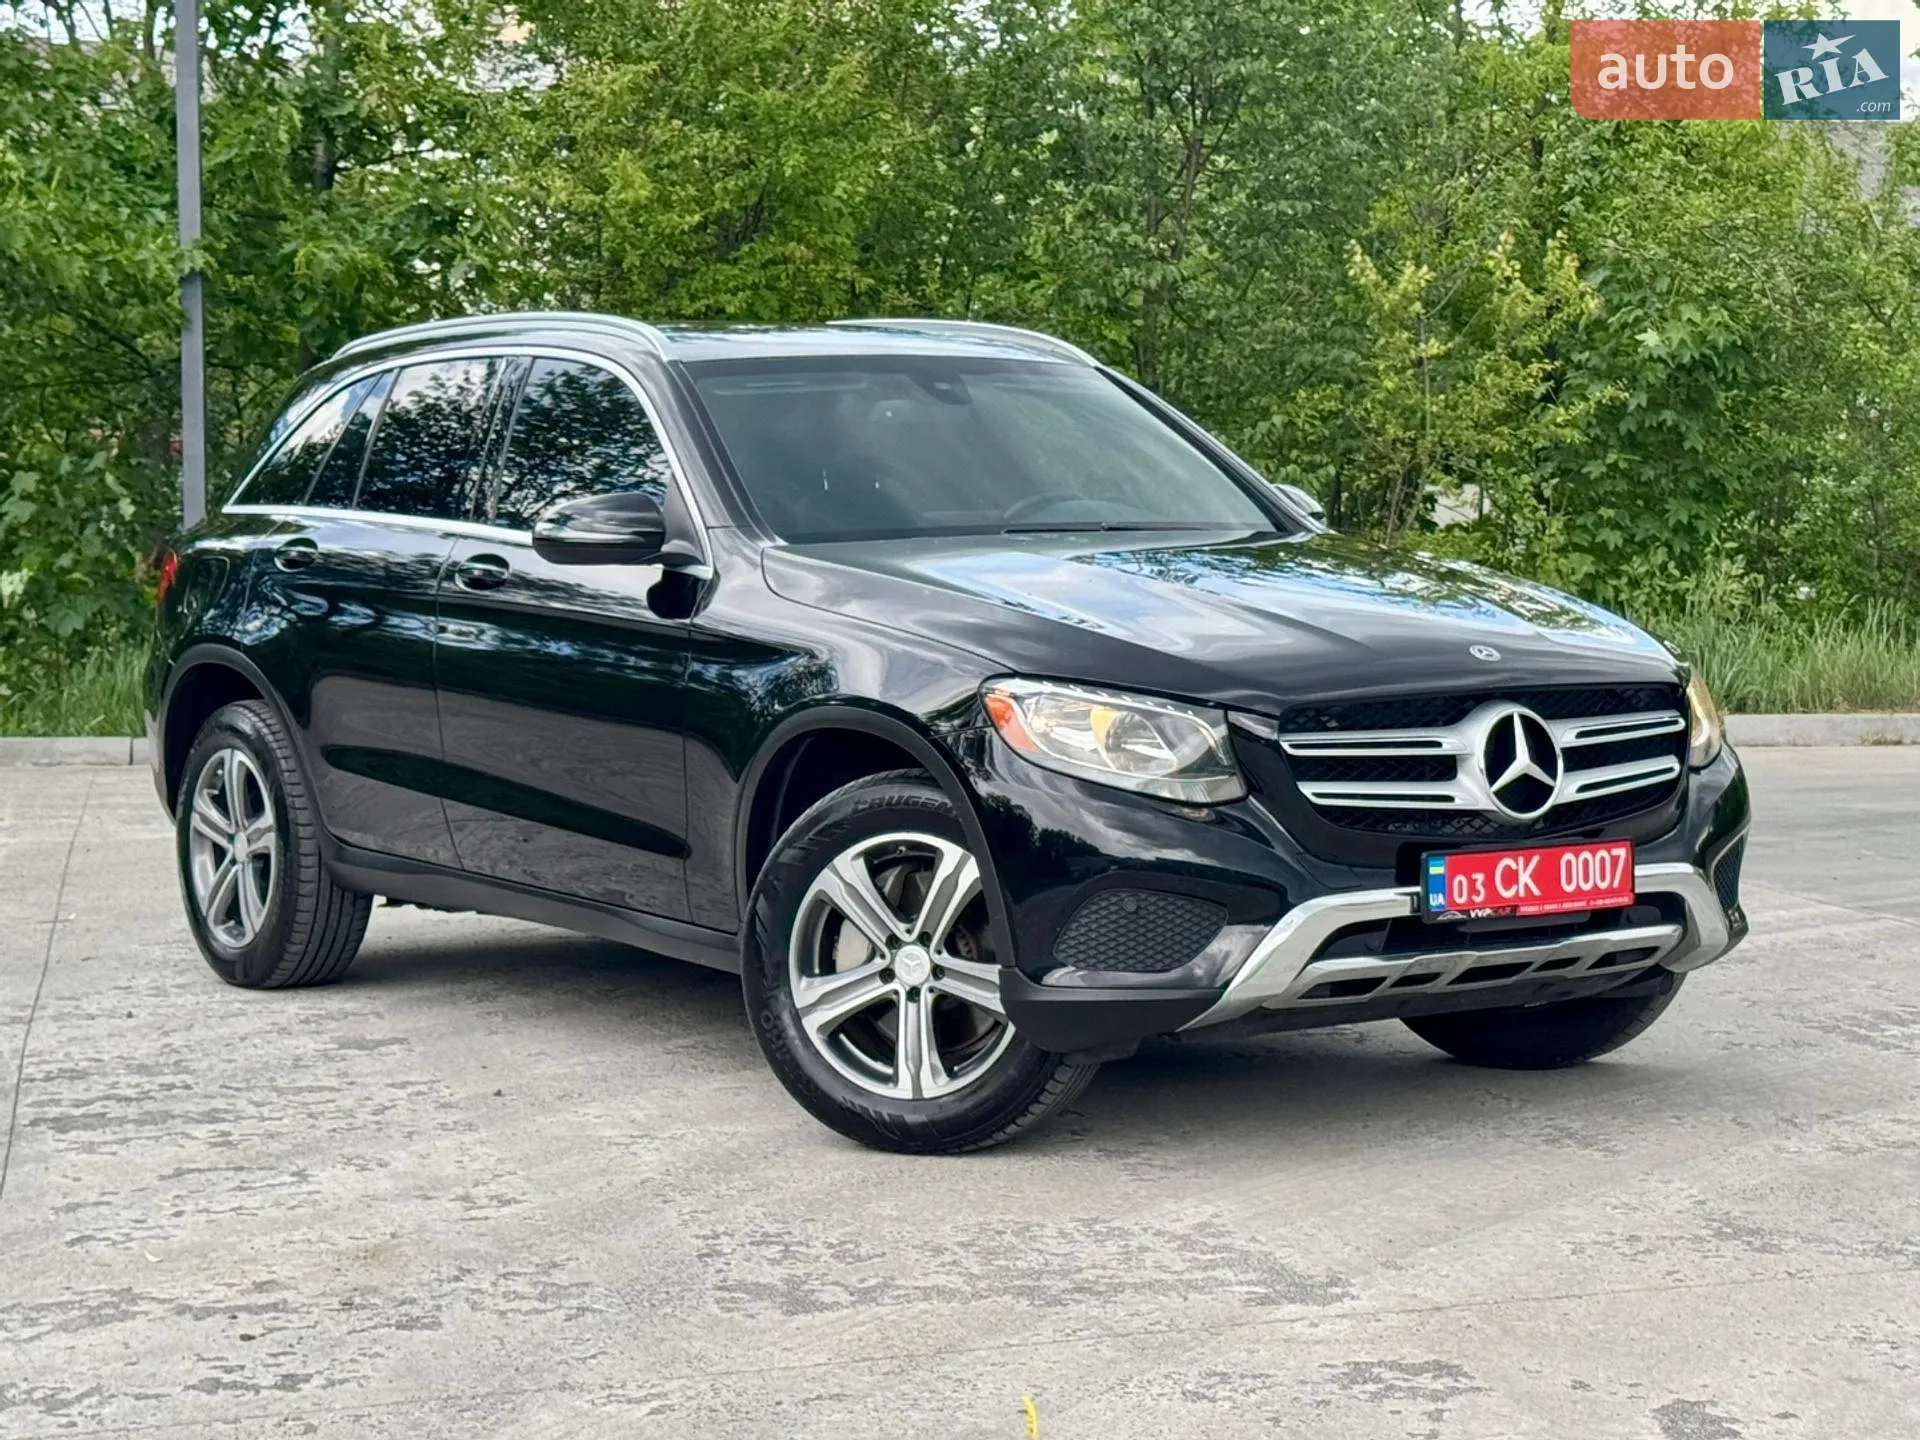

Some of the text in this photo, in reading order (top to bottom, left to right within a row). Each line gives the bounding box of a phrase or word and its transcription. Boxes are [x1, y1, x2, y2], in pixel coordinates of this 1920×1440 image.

[1452, 847, 1627, 904] 03 CK 0007
[1429, 893, 1446, 906] UA
